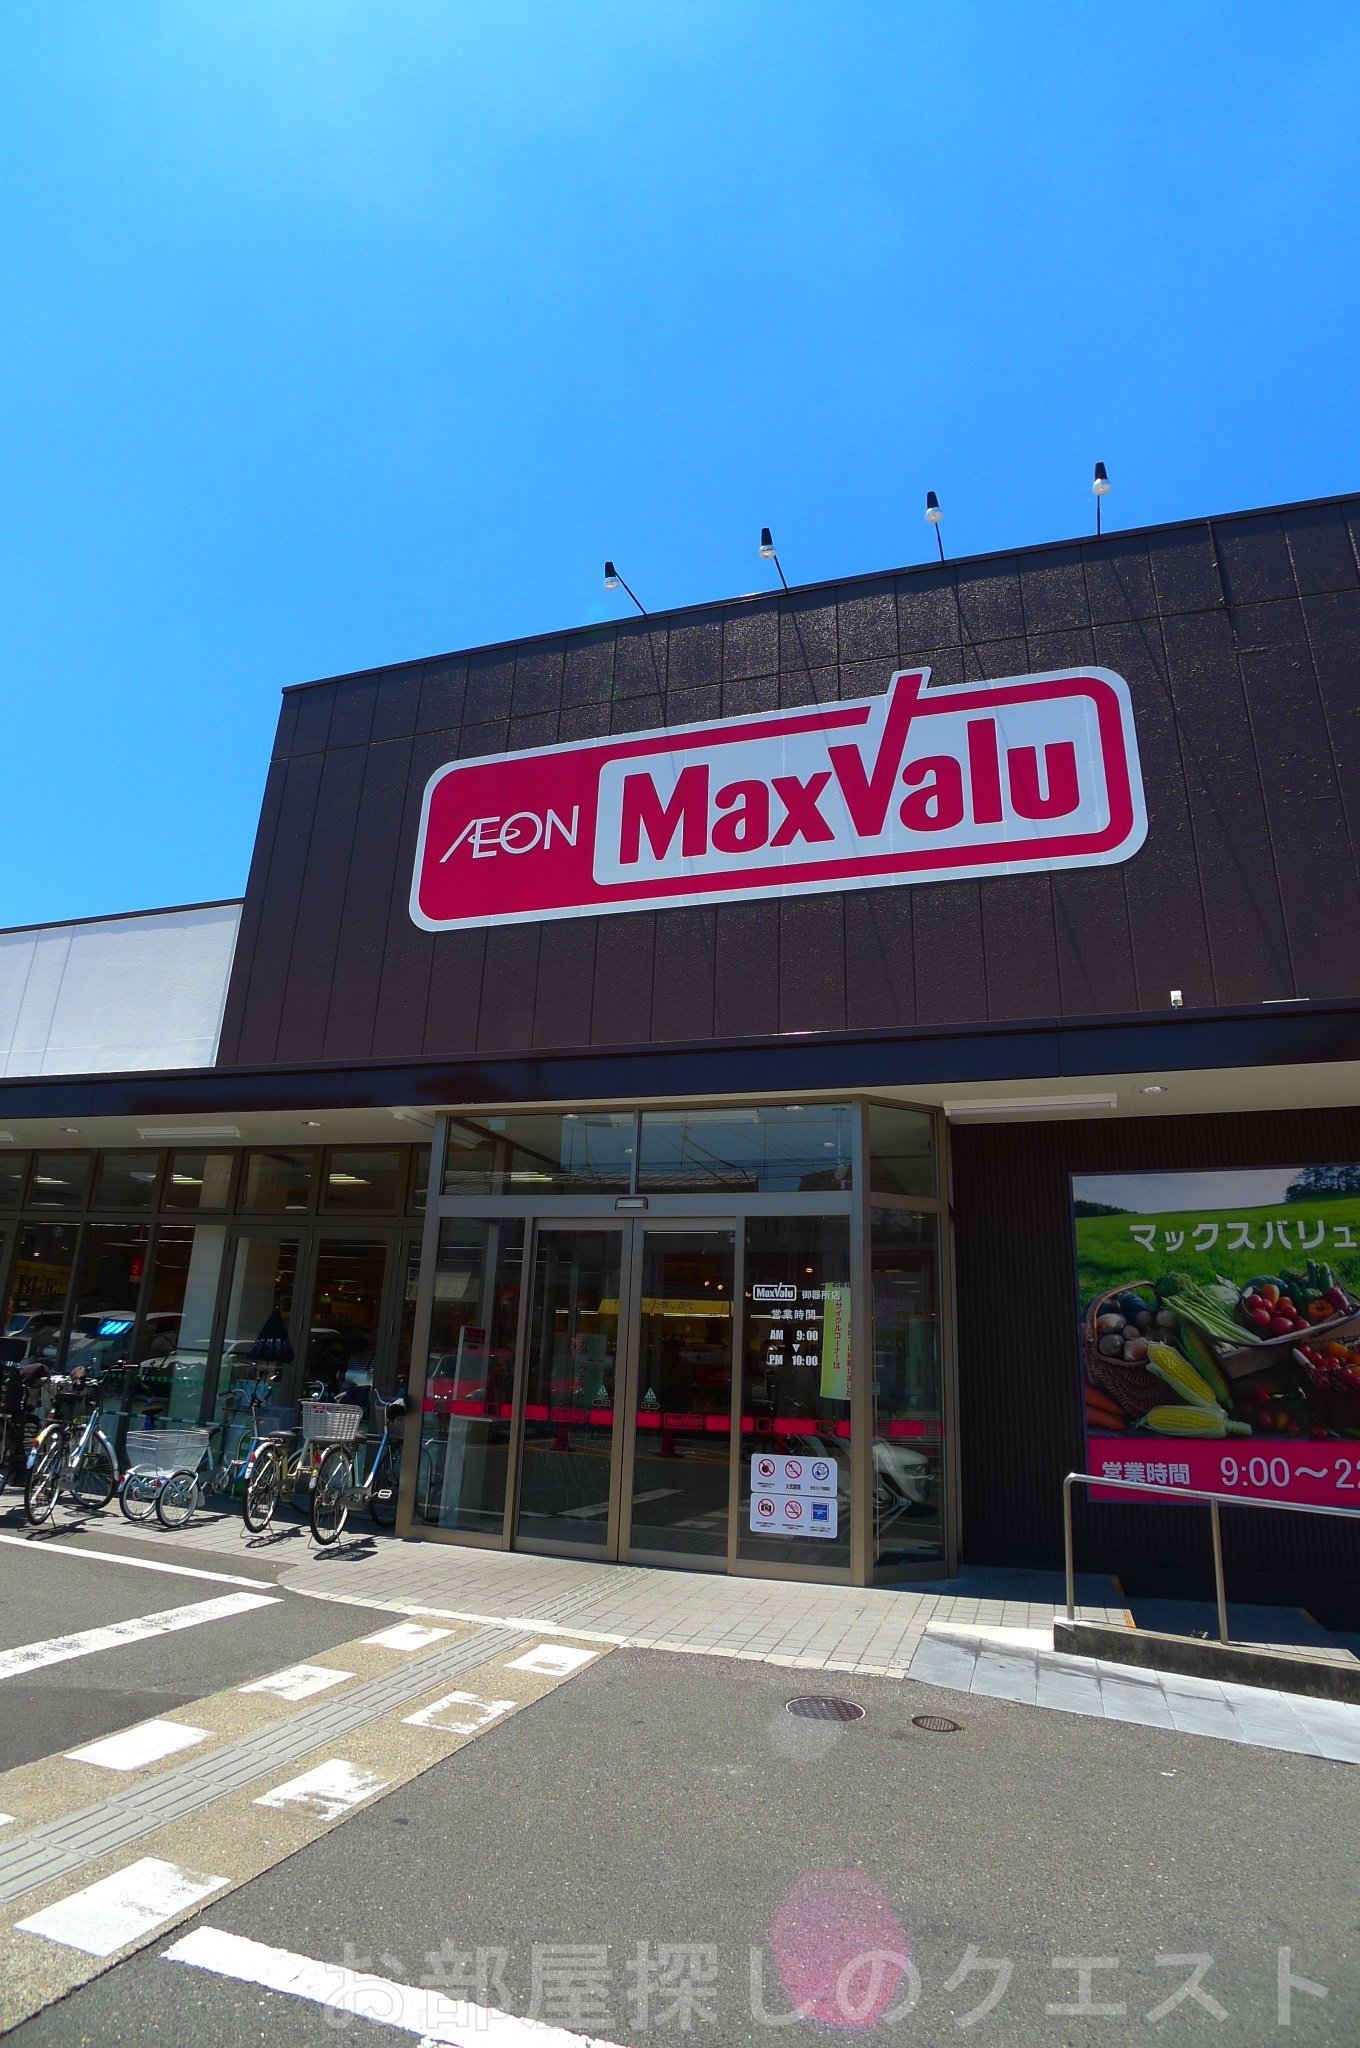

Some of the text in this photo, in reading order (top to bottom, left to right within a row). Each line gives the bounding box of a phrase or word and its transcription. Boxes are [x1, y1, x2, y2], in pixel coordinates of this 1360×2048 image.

[619, 673, 1080, 864] MaxValu
[1129, 1219, 1358, 1252] マックスバリュ
[756, 1282, 793, 1298] MaxValu
[771, 1309, 816, 1321] 営業時間
[770, 1329, 819, 1341] AM 9:00
[769, 1355, 818, 1367] PM 10:00
[1101, 1456, 1360, 1489] 営業時間 9:00〜2
